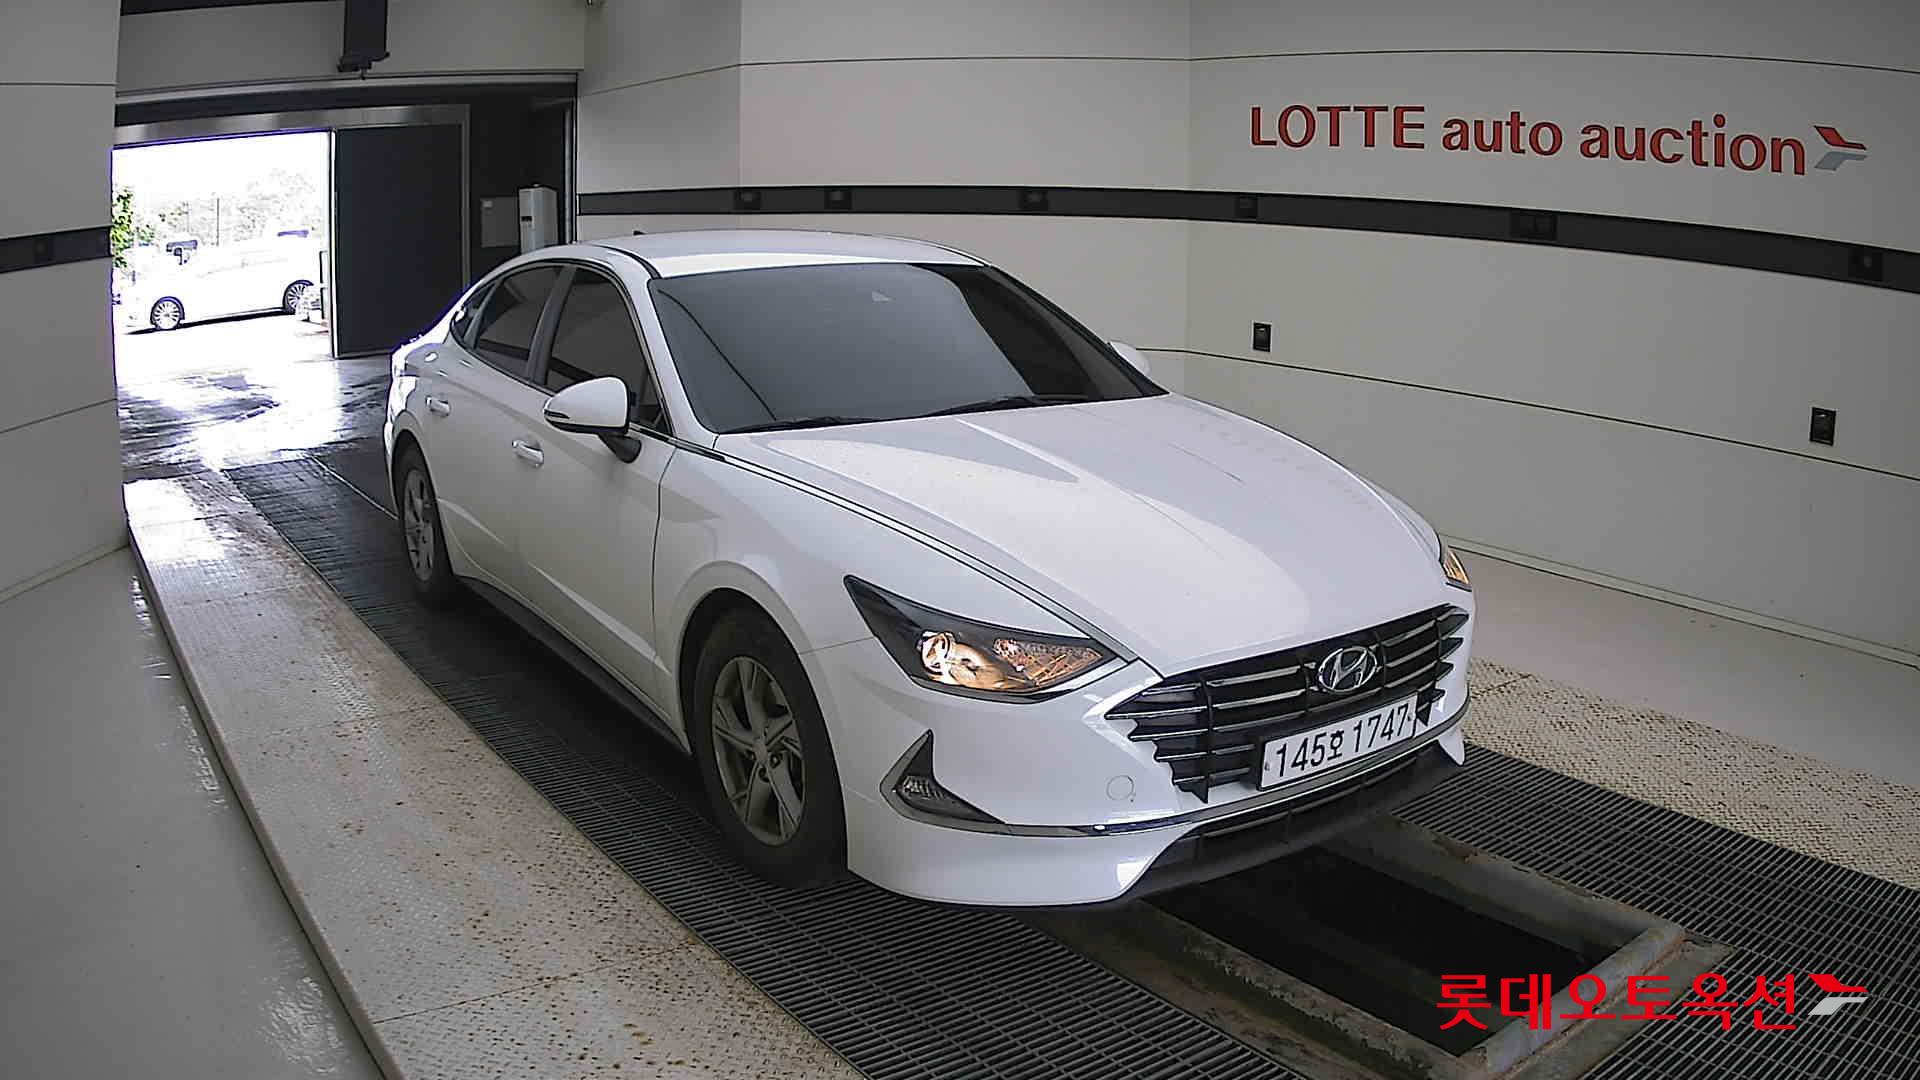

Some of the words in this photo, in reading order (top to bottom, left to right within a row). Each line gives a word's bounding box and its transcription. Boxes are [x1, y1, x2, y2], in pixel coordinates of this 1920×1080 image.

[1250, 105, 1426, 151] LOTTE
[1442, 110, 1564, 157] auto
[1579, 113, 1807, 176] auction
[1276, 730, 1345, 778] 145호
[1353, 702, 1410, 754] 1747
